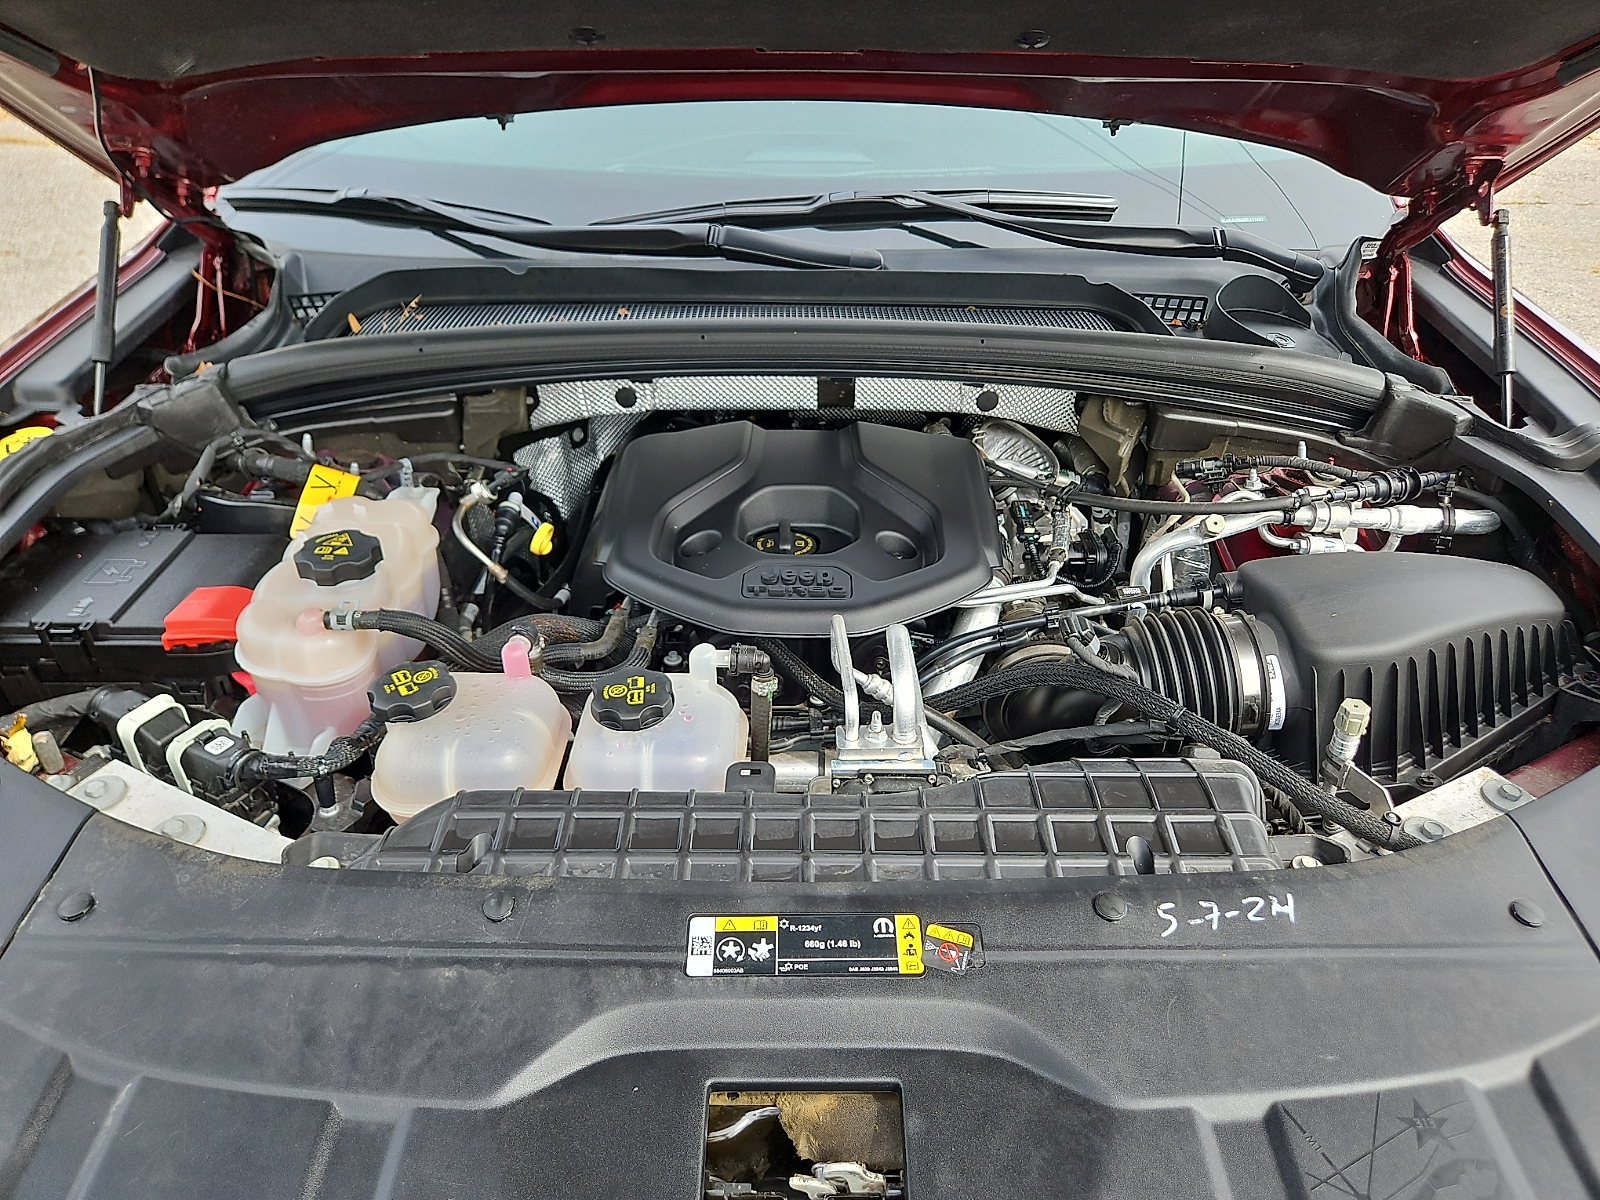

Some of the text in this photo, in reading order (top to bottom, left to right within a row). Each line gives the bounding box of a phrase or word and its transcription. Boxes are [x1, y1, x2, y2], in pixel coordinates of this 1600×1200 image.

[760, 566, 834, 586] Jeep
[789, 924, 823, 933] R-1234yf
[849, 939, 862, 950] lb)
[793, 963, 809, 971] POE
[1412, 1117, 1437, 1130] 313
